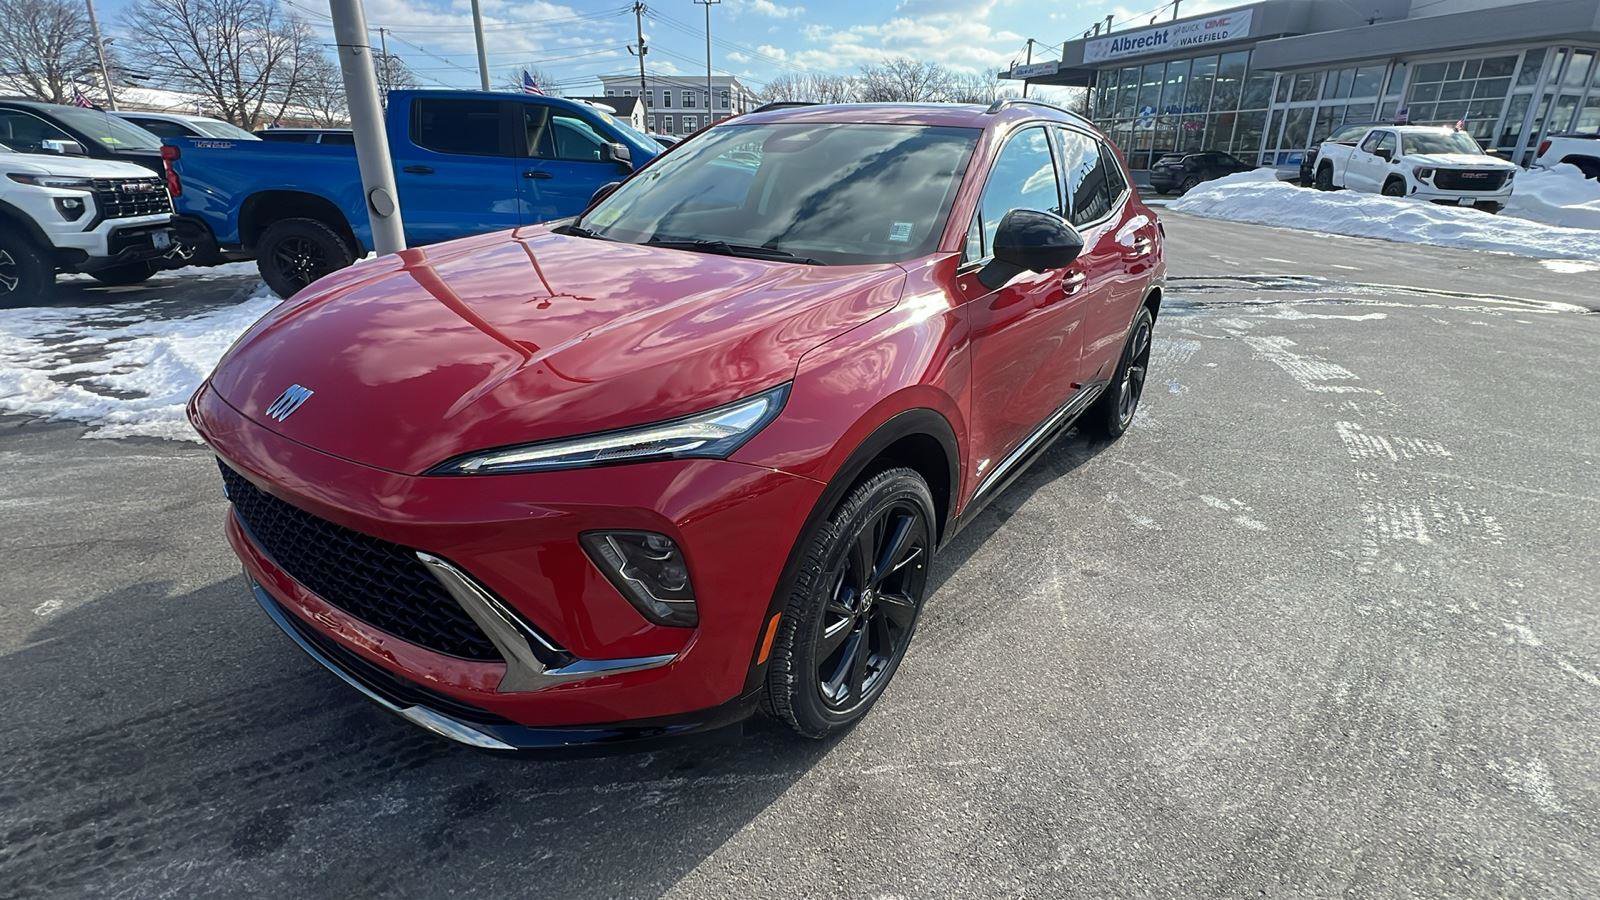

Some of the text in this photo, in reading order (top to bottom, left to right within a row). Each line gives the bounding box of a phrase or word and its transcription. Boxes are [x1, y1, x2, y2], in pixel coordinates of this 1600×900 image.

[1205, 17, 1231, 29] GMC
[1110, 30, 1168, 53] Albrecht
[1180, 31, 1228, 46] WAKEFIELD
